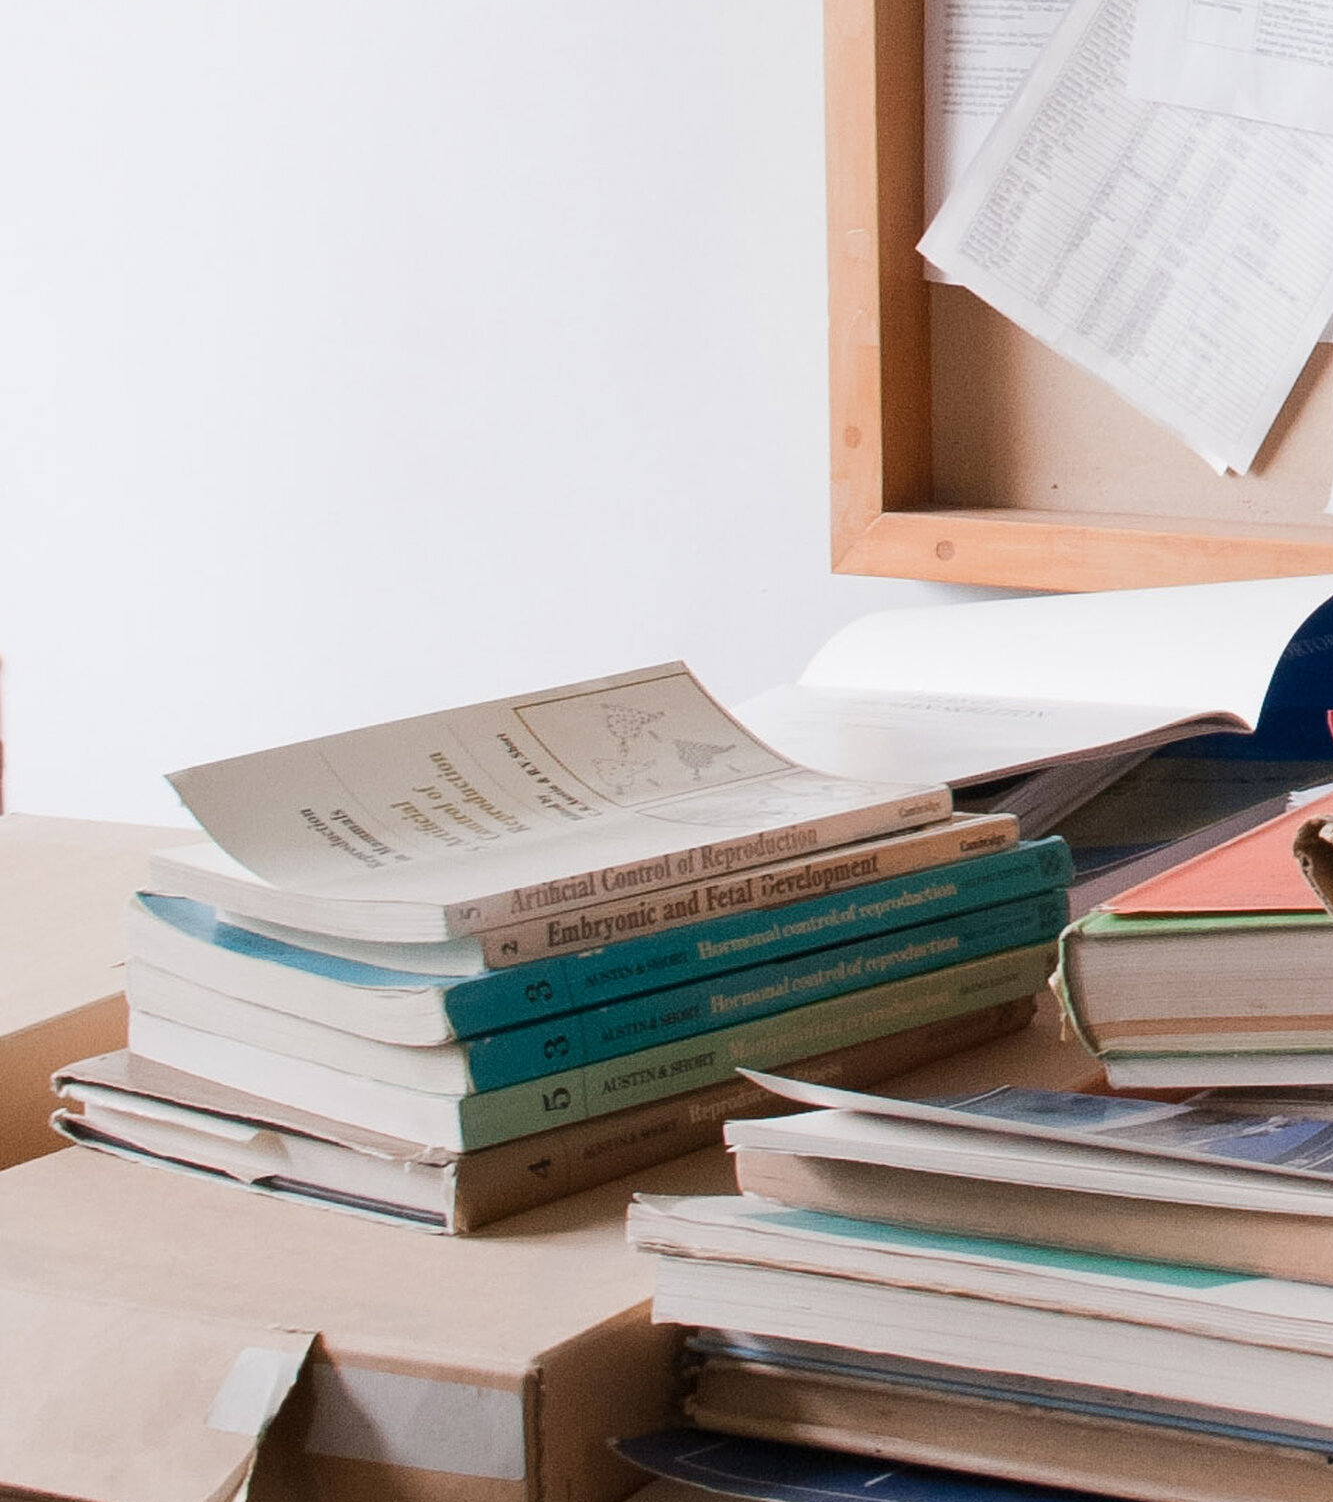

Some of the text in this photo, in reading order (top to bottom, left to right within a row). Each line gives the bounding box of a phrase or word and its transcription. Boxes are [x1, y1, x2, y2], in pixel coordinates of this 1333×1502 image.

[389, 800, 463, 848] Artificial
[411, 785, 501, 841] Control of
[429, 750, 533, 835] Reproduction
[300, 807, 386, 870] Reproduction
[330, 808, 391, 856] Mammals
[509, 873, 595, 915] Artificial
[601, 854, 671, 895] Control
[679, 846, 698, 874] of
[701, 825, 817, 871] Reproduction
[545, 899, 659, 949] Embryonic
[662, 889, 700, 921] and
[704, 875, 752, 912] Fetal
[761, 854, 877, 898] Development
[524, 979, 552, 1004] 3
[697, 925, 781, 961] Hormonal
[782, 910, 837, 939] control
[858, 882, 958, 917] reproduction
[543, 1034, 570, 1060] 3
[710, 977, 789, 1013] Hormonal
[790, 961, 845, 993] control
[864, 935, 959, 973] reproduction
[541, 1087, 571, 1112] 5
